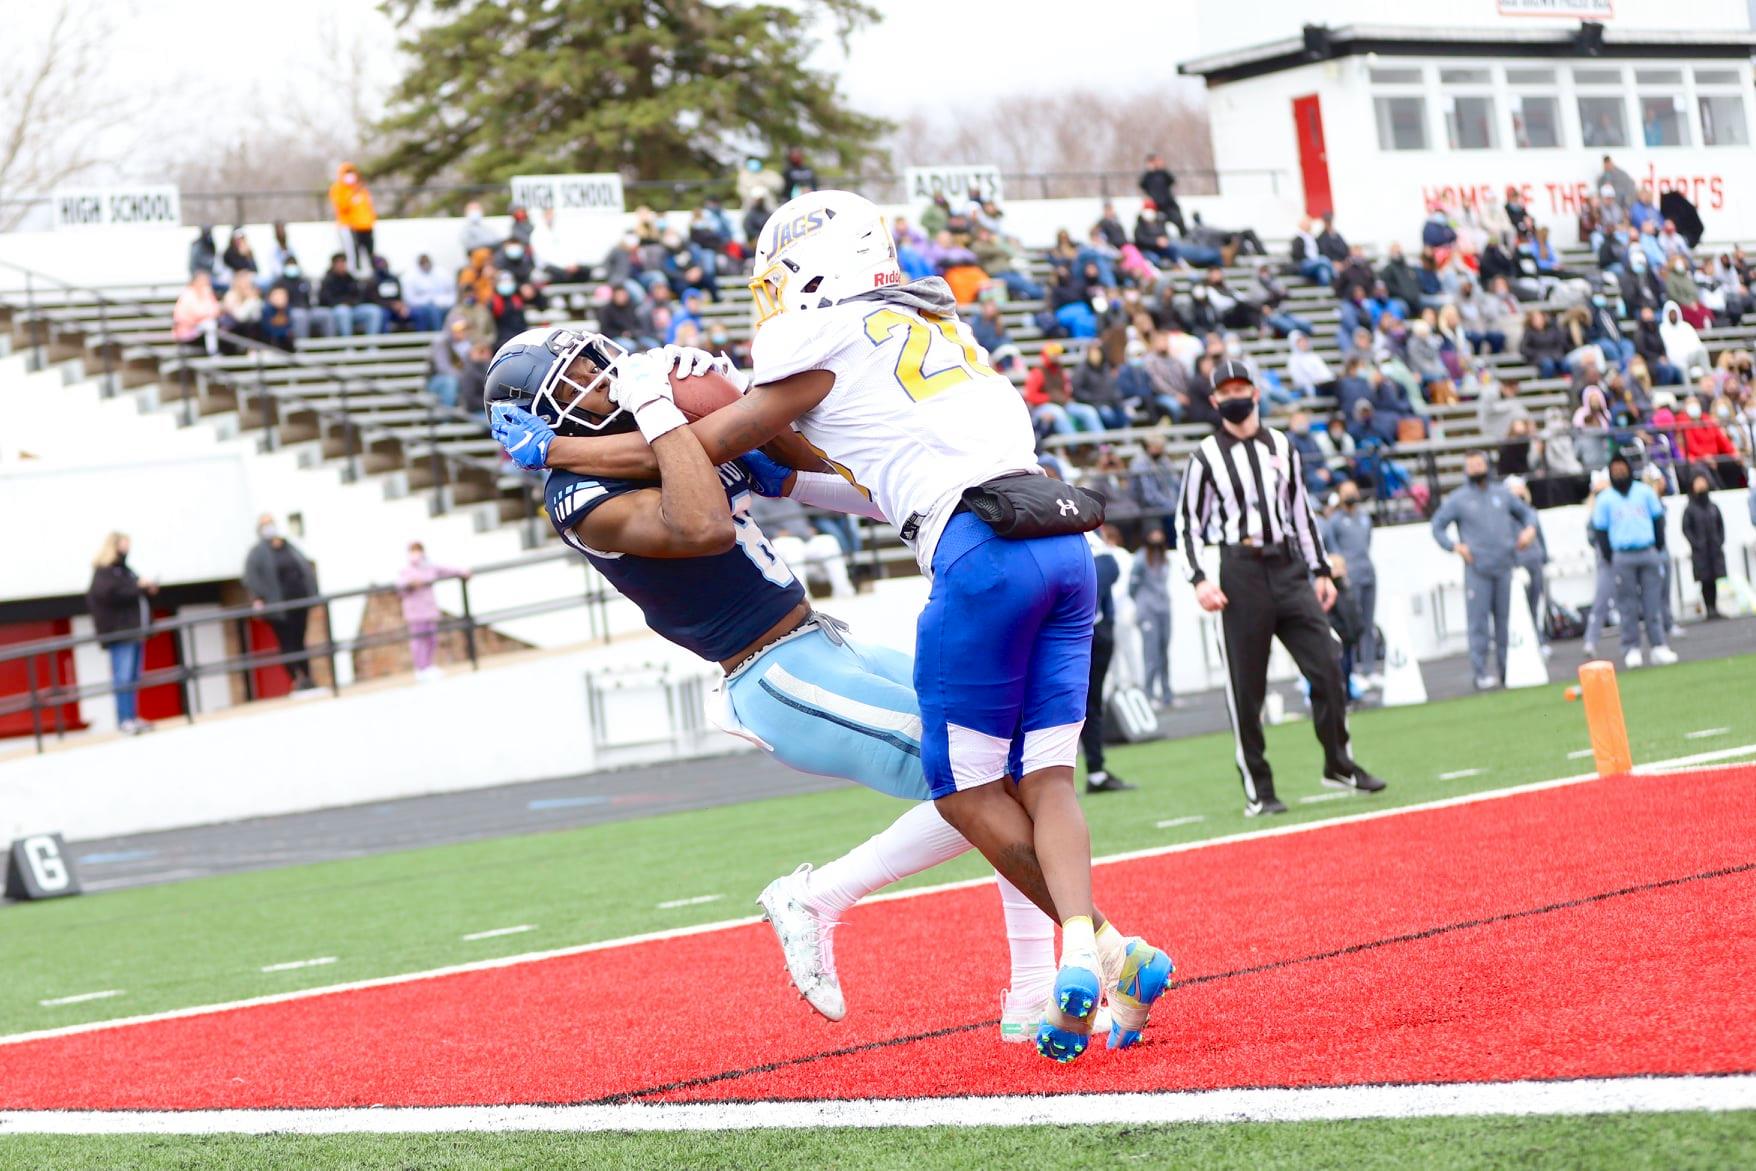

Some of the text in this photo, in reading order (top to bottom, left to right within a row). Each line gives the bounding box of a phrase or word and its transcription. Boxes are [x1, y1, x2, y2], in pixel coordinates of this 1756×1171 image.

[61, 192, 174, 224] HIGH SCHOOL
[519, 181, 618, 209] HIGH SCHOOL
[766, 207, 824, 262] JAGS
[873, 270, 901, 288] Ridd
[1114, 687, 1158, 735] 10
